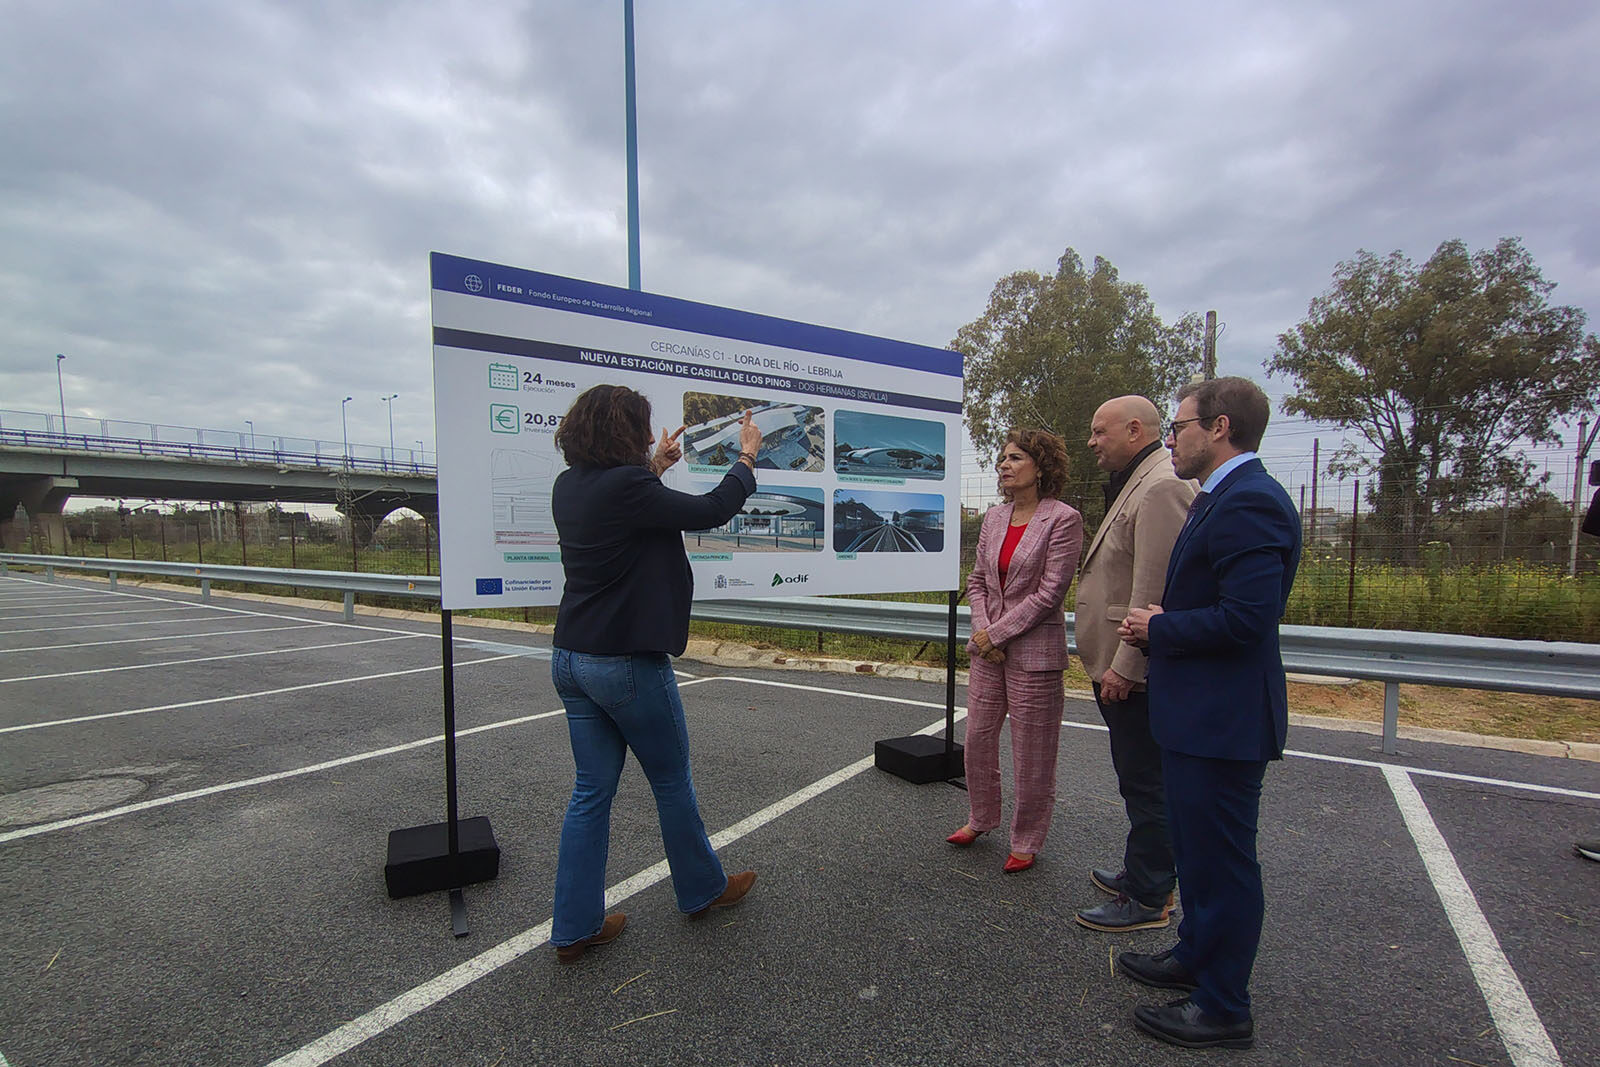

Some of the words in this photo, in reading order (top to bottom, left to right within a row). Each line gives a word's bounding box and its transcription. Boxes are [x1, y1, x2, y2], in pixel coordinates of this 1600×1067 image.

[497, 283, 523, 294] FEDER
[528, 289, 551, 299] Fondo
[552, 293, 581, 304] Europeo
[591, 300, 625, 312] Desarrollo
[625, 306, 653, 317] Regional
[650, 340, 711, 359] CERCANÍAS
[712, 350, 725, 361] C1
[734, 353, 761, 367] LORA
[763, 358, 781, 370] DEL
[783, 359, 800, 373] RÍO
[807, 365, 844, 379] LEBRIJA
[523, 371, 543, 385] 24
[545, 379, 576, 388] meses
[580, 350, 619, 365] NUEVA
[620, 356, 674, 373] ESTACIÓN
[675, 364, 689, 375] DE
[690, 366, 731, 381] CASILLA
[732, 372, 745, 382] DE
[745, 374, 764, 385] LOS
[765, 376, 792, 389] PINOS
[798, 381, 815, 392] DOS
[816, 384, 856, 398] HERMANAS
[857, 390, 888, 403] (SEVILLA)
[523, 384, 556, 393] Ejecución
[524, 426, 554, 434] Inversión
[784, 574, 809, 584] adif
